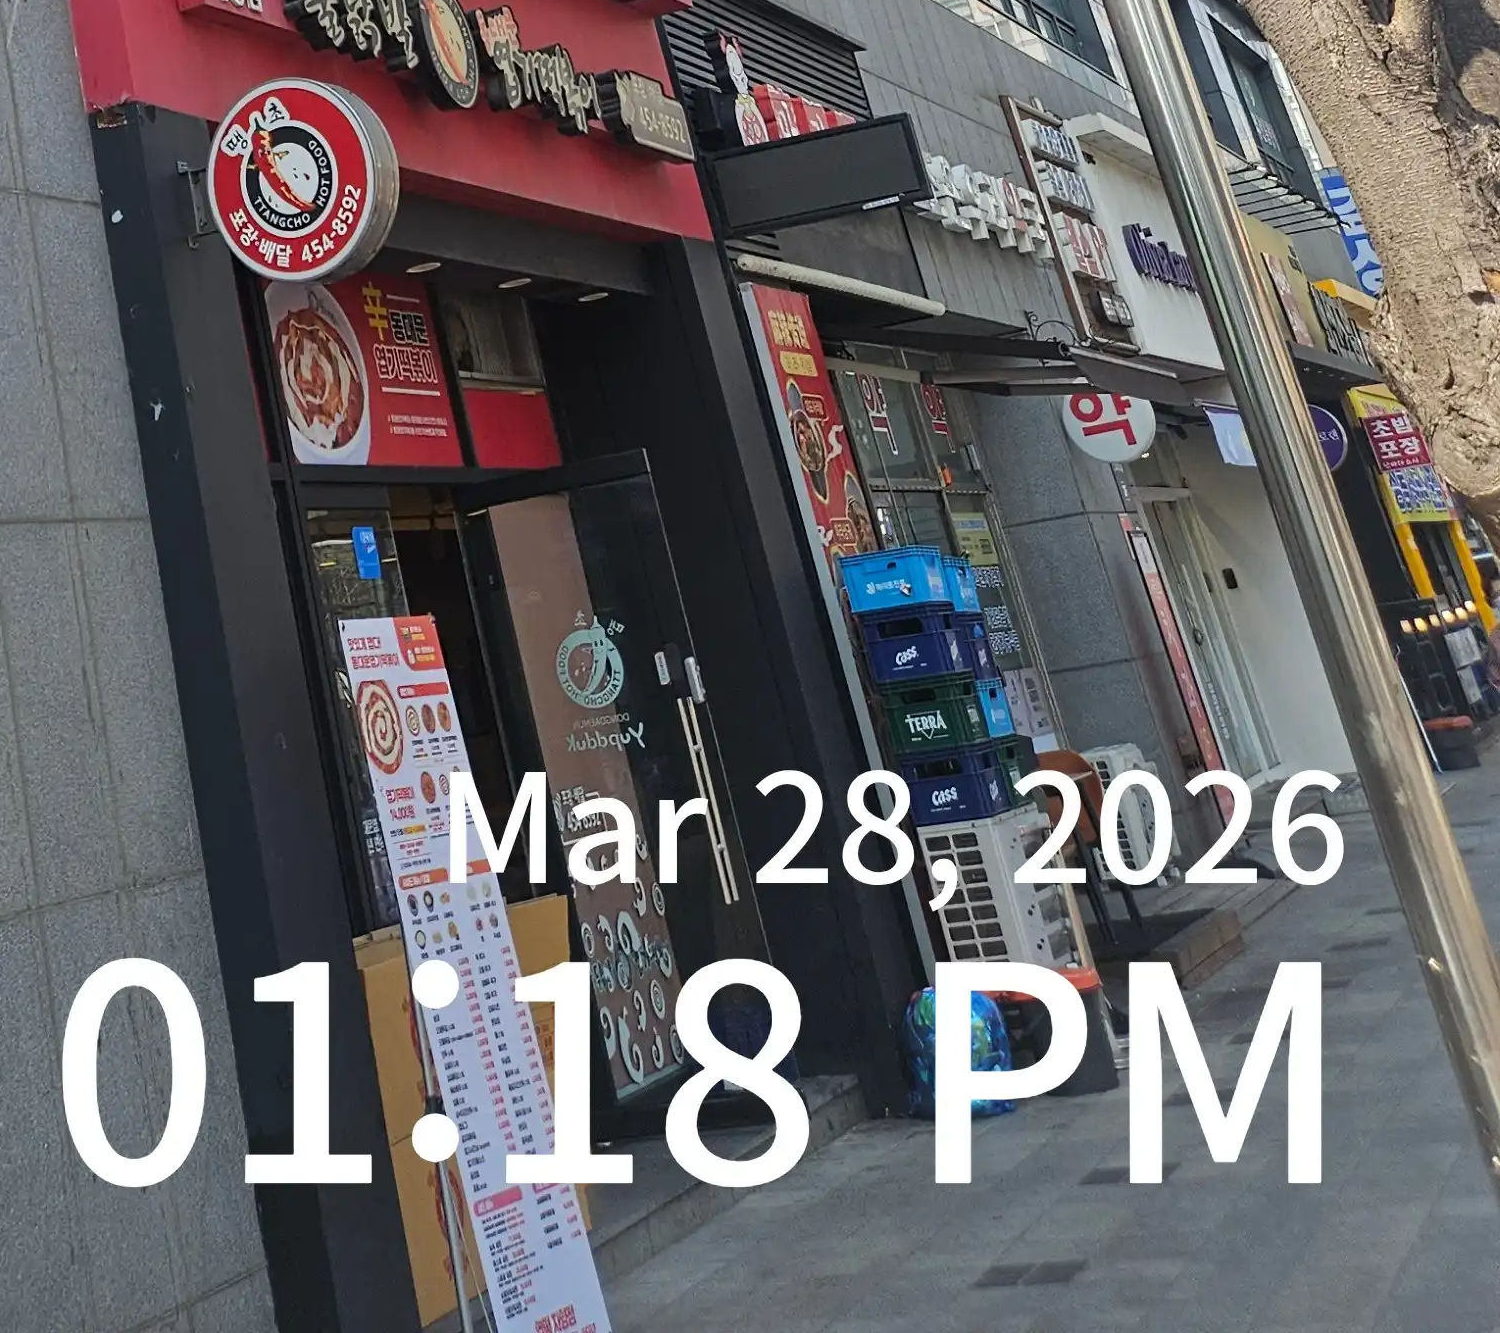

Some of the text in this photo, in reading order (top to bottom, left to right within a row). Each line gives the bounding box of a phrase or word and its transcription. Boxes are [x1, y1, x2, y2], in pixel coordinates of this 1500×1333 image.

[225, 102, 285, 152] 땡 초
[253, 139, 332, 229] TTANGCHO HOT FOOD
[301, 184, 362, 264] 454-8592
[388, 308, 431, 347] 동대문
[372, 343, 439, 384] 엽기떡볶이
[856, 374, 899, 456] 약
[1069, 391, 1138, 446] 약
[1378, 436, 1421, 460] 포장
[905, 709, 948, 734] TERRA
